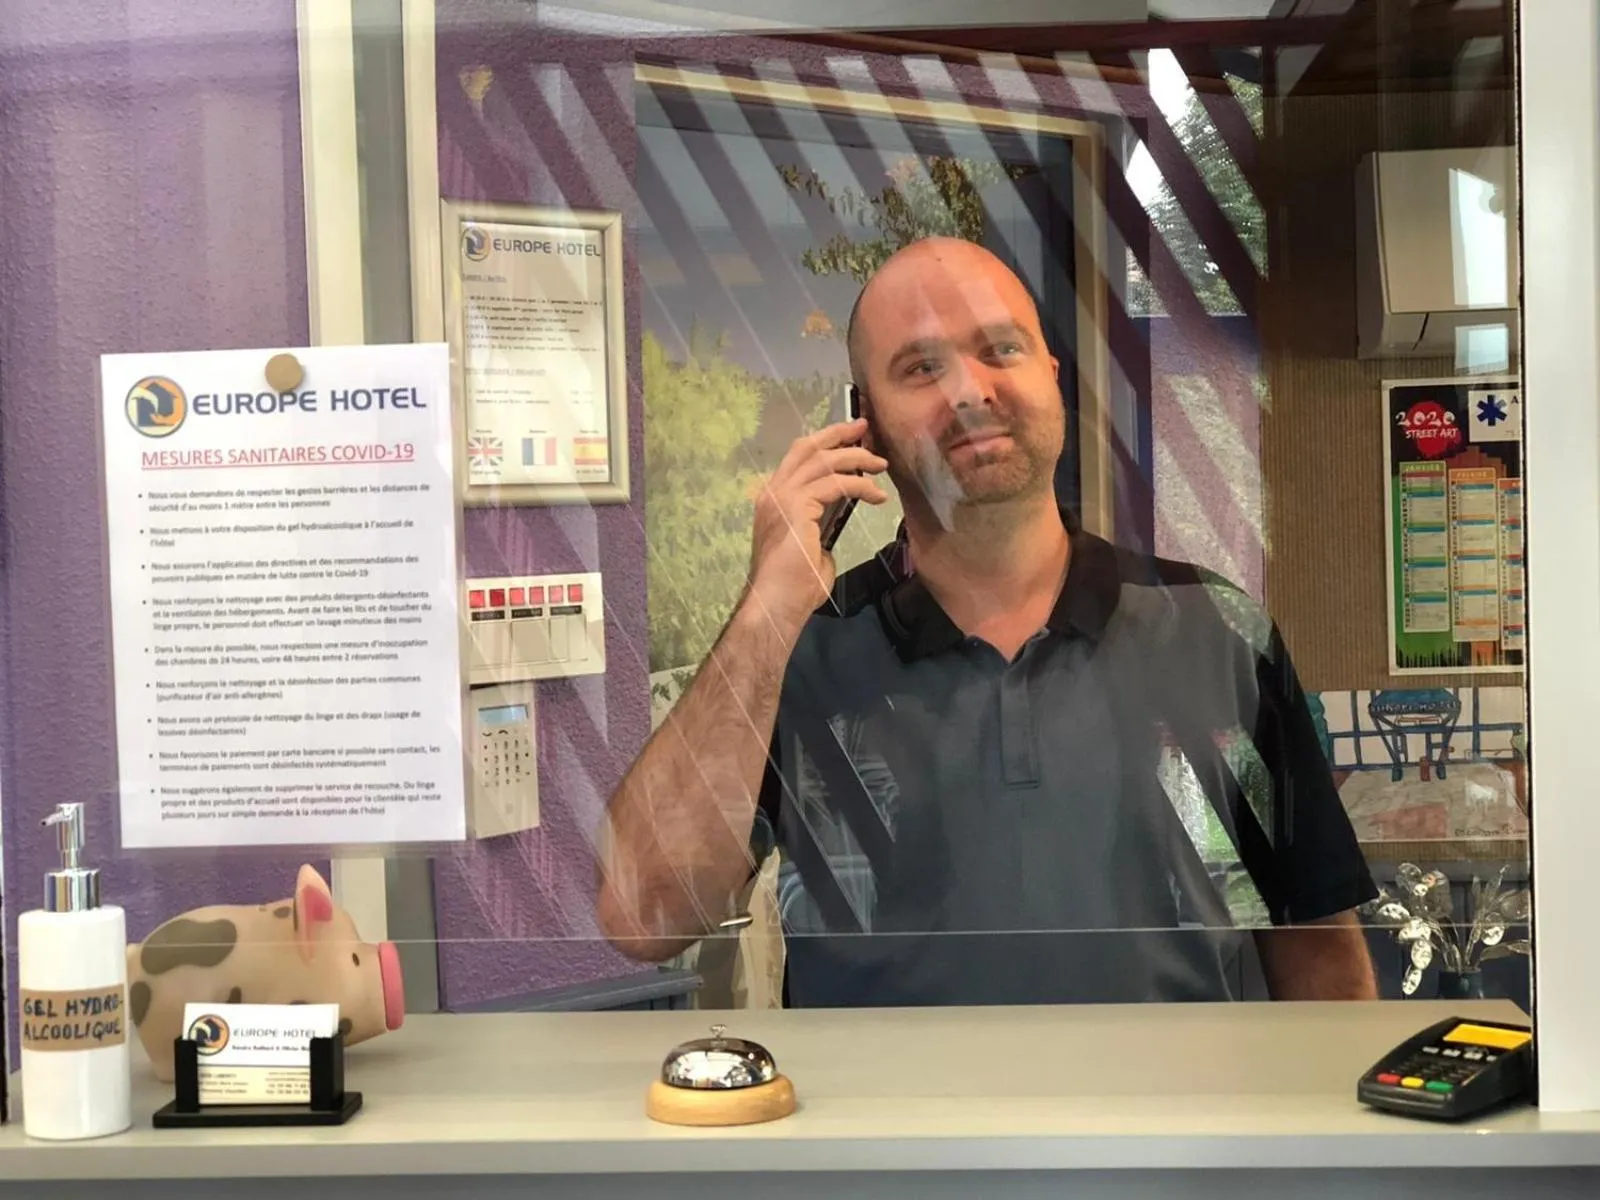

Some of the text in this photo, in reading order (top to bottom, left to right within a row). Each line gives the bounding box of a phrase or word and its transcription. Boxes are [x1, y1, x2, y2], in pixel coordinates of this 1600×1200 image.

[493, 239, 601, 257] EUROPE HOTEL
[192, 387, 427, 415] EUROPE HOTEL
[1395, 411, 1456, 427] 2020
[1405, 428, 1459, 439] STREET ART
[142, 443, 414, 467] MESURES SANITAIRES COVID-19
[24, 993, 123, 1018] GEL HYDRO-
[24, 1019, 121, 1041] ALCOOLIQUE
[233, 1028, 278, 1038] EUROPE
